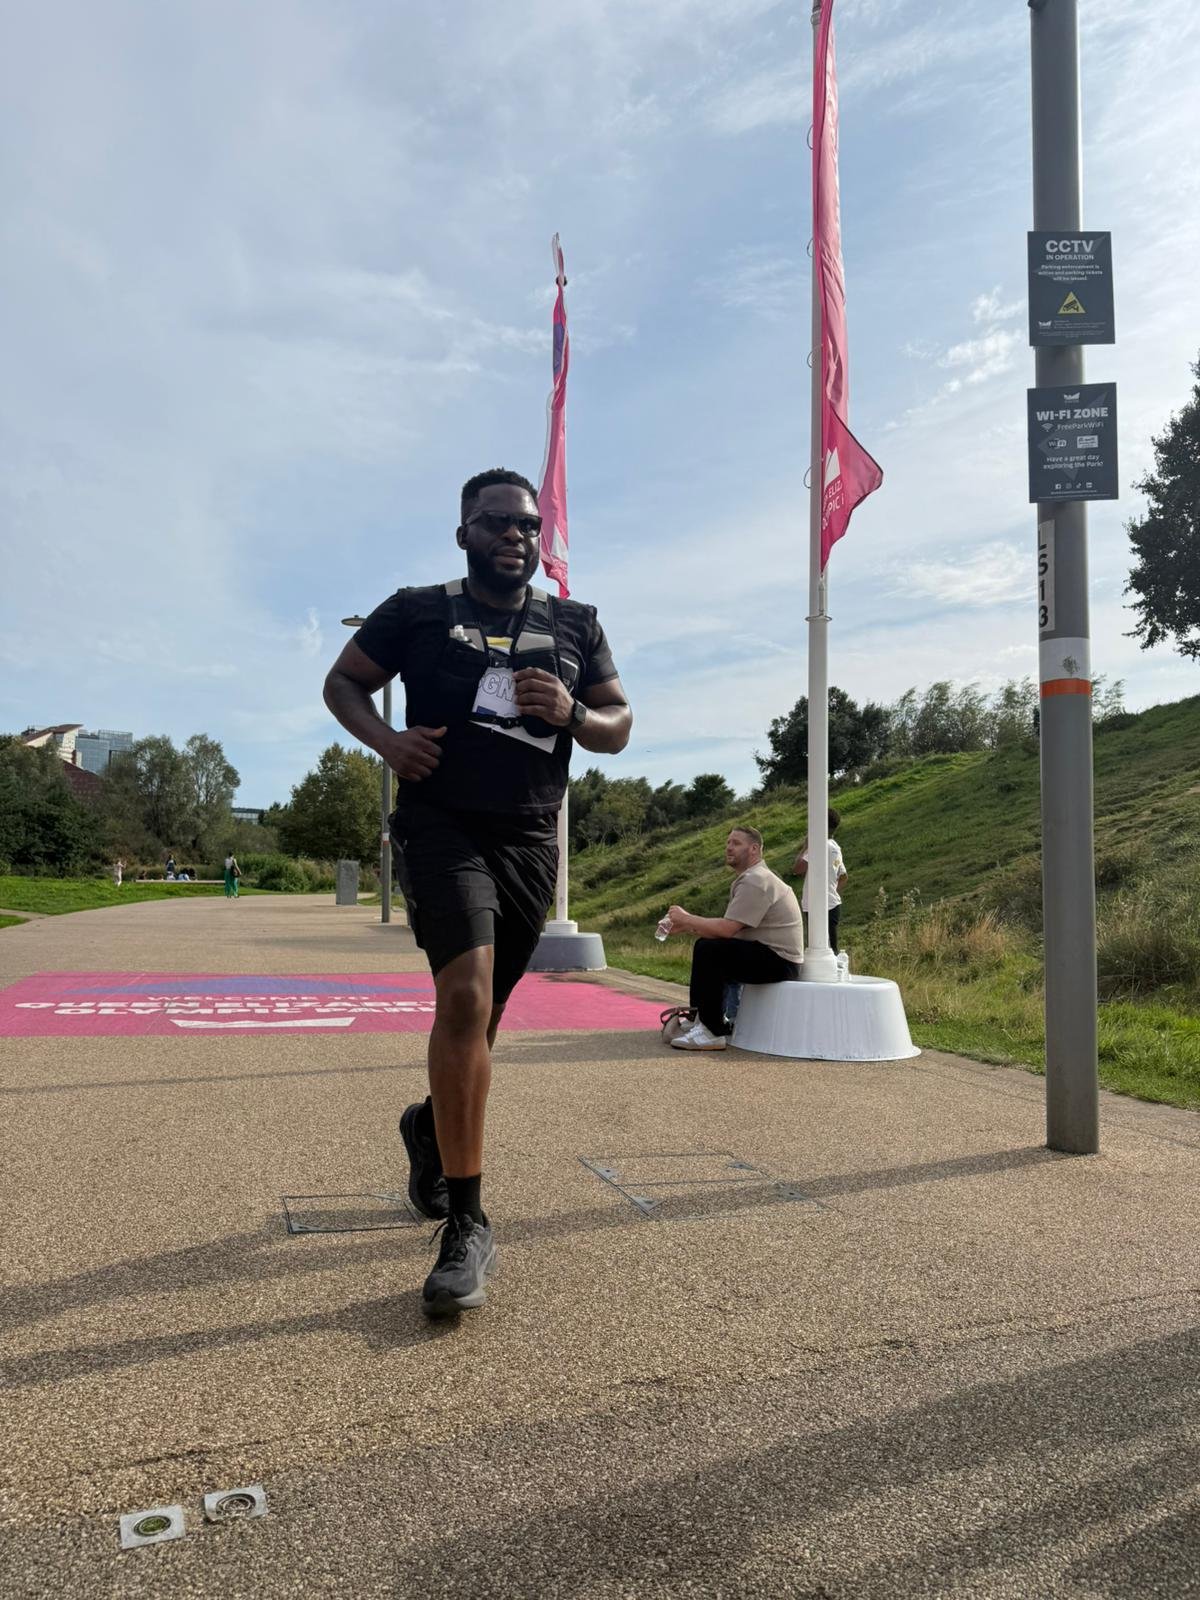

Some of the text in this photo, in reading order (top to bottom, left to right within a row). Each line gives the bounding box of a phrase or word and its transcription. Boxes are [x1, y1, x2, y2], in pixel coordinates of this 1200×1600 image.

[1046, 240, 1093, 252] CCTV
[1036, 407, 1109, 421] WI-FI ZONE
